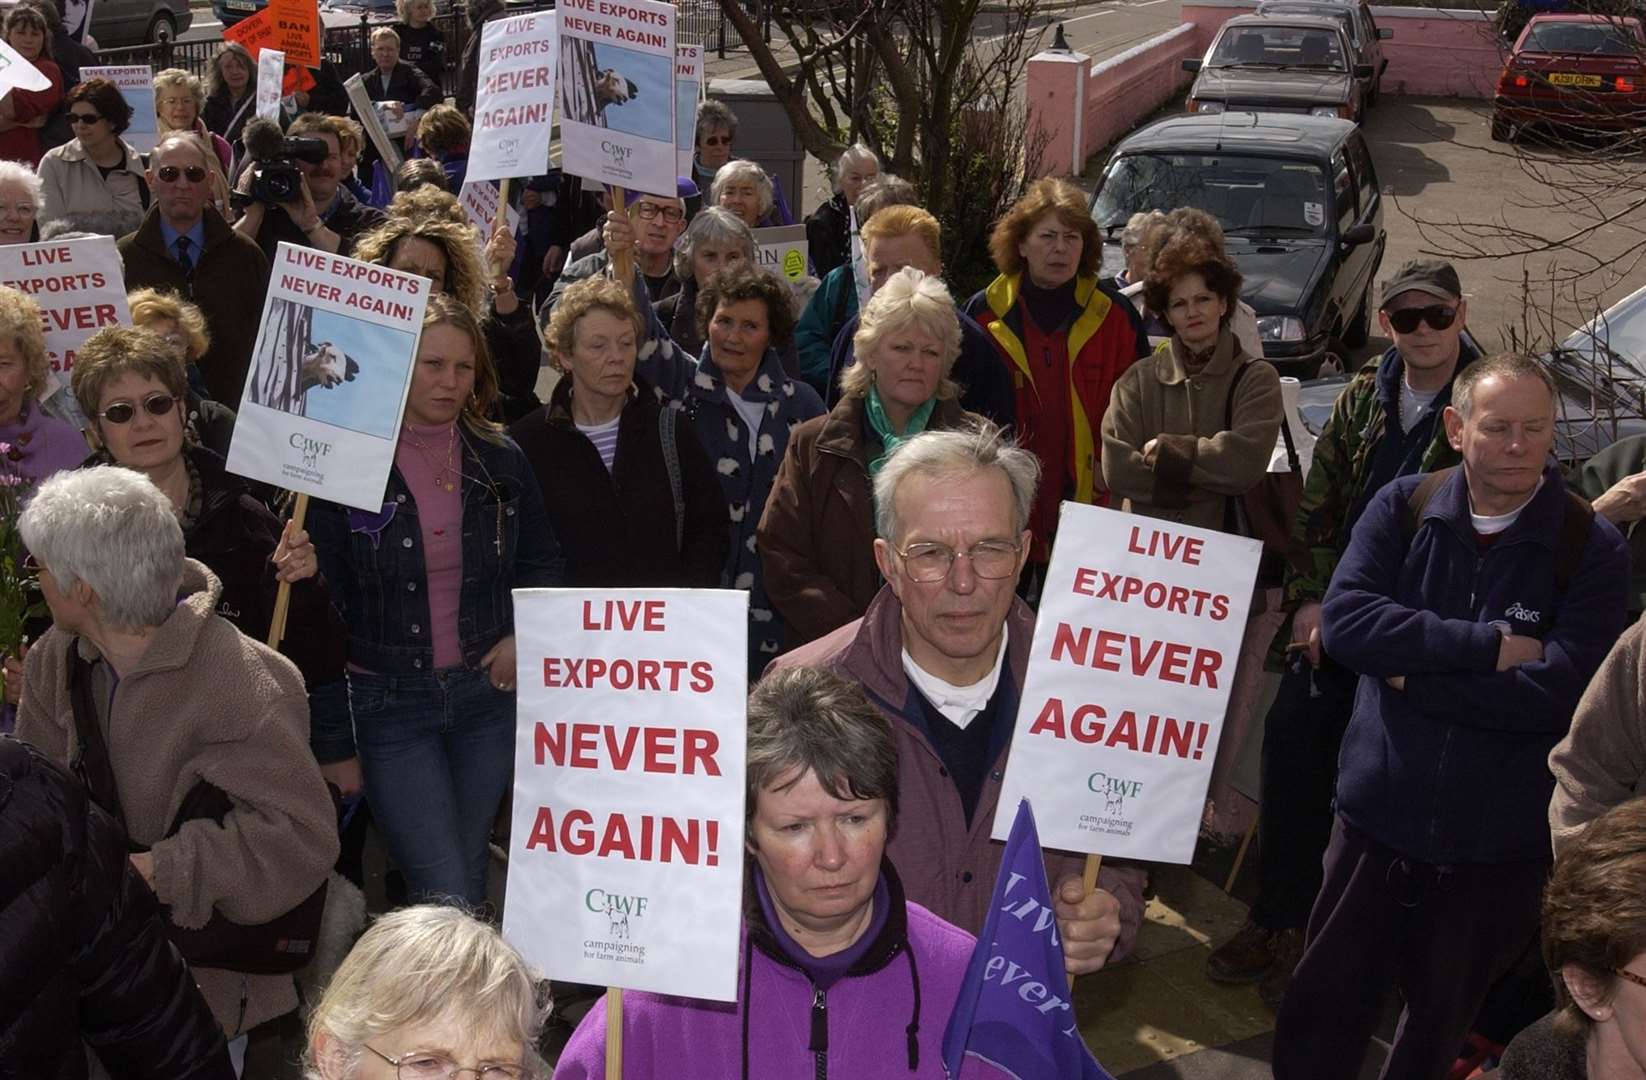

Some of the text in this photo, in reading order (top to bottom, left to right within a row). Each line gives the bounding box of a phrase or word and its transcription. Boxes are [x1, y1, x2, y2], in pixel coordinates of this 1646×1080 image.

[279, 20, 310, 33] BAN
[506, 18, 536, 35] LIVE
[600, 2, 667, 26] EXPORTS
[564, 16, 667, 48] NEVER AGAIN!
[490, 40, 549, 62] EXPORTS
[484, 67, 549, 96] NEVER
[481, 103, 548, 130] AGAIN!
[22, 247, 72, 266] LIVE
[285, 249, 420, 294] LIVE EXPORTS
[280, 274, 414, 321] NEVER AGAIN!
[40, 304, 118, 332] EVER
[289, 432, 332, 456] CIWF
[1128, 526, 1205, 566] LIVE
[1072, 567, 1230, 621] EXPORTS
[583, 600, 666, 631] LIVE
[1050, 622, 1223, 689] NEVER
[543, 657, 714, 693] EXPORTS
[1029, 697, 1210, 761] AGAIN!
[534, 721, 722, 777] NEVER
[1088, 772, 1143, 798] CIWF
[525, 806, 720, 867] AGAIN!
[1079, 814, 1134, 830] campaigning
[585, 888, 649, 917] CIWF
[583, 940, 646, 956] campaigning
[583, 951, 644, 964] for farm animals
[984, 946, 1071, 1015] ever
